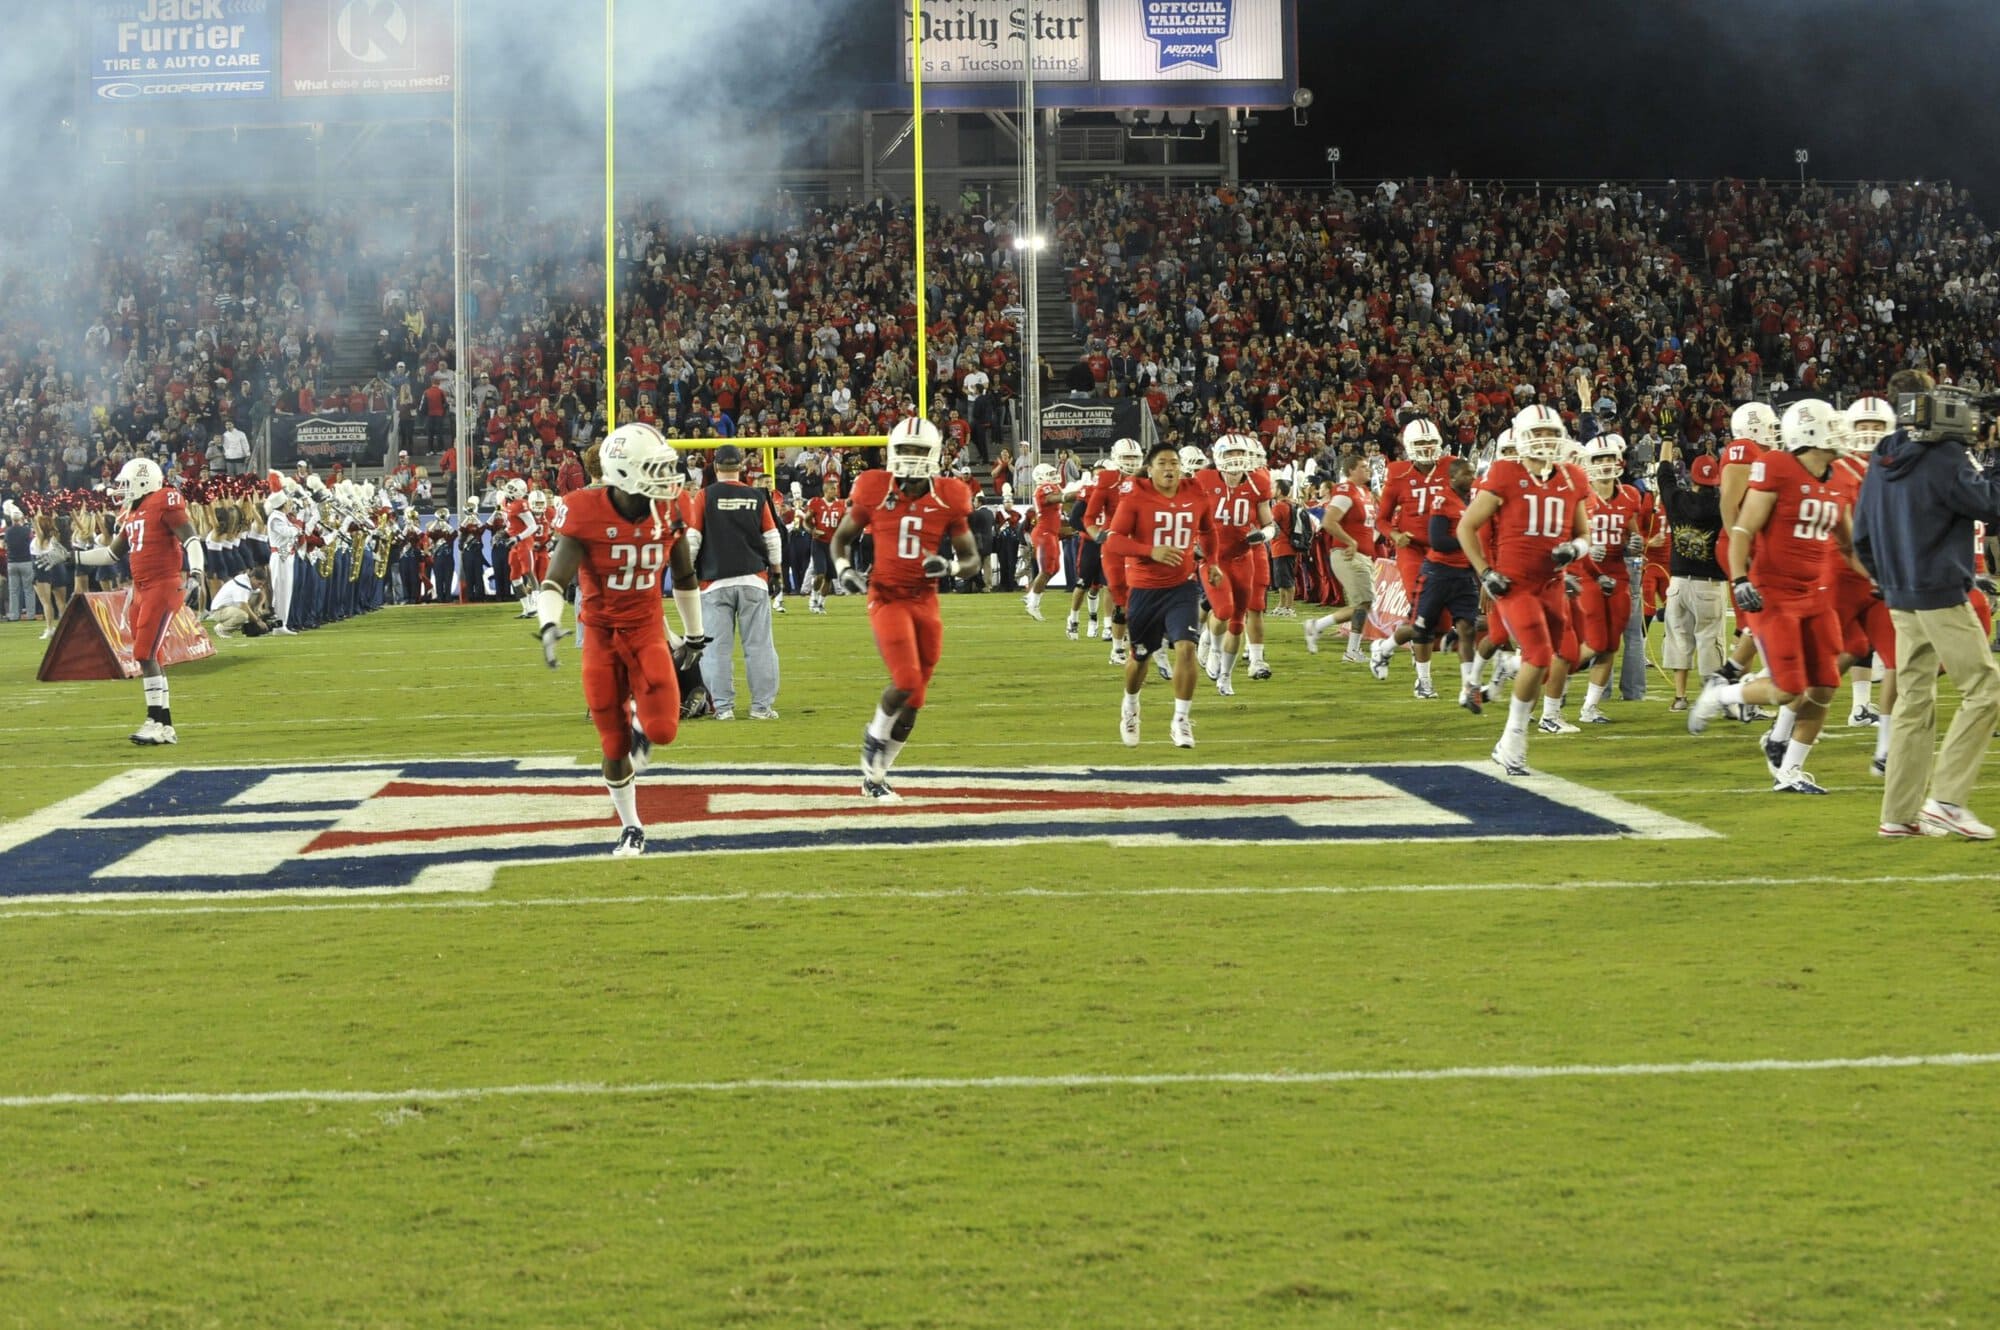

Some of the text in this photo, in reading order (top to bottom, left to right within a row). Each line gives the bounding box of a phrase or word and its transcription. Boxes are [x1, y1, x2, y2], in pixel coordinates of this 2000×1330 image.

[138, 0, 224, 22] Jack
[1148, 2, 1226, 14] OFFICIAL
[904, 8, 1085, 49] Daily Star
[1148, 15, 1226, 26] TAILGATE
[118, 22, 245, 53] Furrier
[1149, 27, 1226, 36] HEADQUARTERS
[1162, 44, 1214, 54] ARIZONA
[103, 54, 261, 72] TIRE & AUTO CARE
[907, 56, 934, 72] I's
[940, 60, 951, 72] a
[958, 55, 1024, 72] Tucson
[294, 74, 450, 92] What else do you need?
[1328, 148, 1340, 161] 29
[1795, 149, 1808, 162] 30
[1043, 411, 1083, 419] AMERICAN
[1729, 445, 1744, 460] 67
[167, 491, 181, 506] 27
[717, 498, 758, 511] ESPN
[821, 510, 839, 528] 46
[1214, 496, 1250, 527] 40
[1523, 494, 1565, 538] 10
[1793, 498, 1838, 541] 90
[898, 516, 923, 560] 6
[1153, 511, 1194, 549] 26
[1591, 513, 1625, 545] 85
[607, 543, 664, 591] 39
